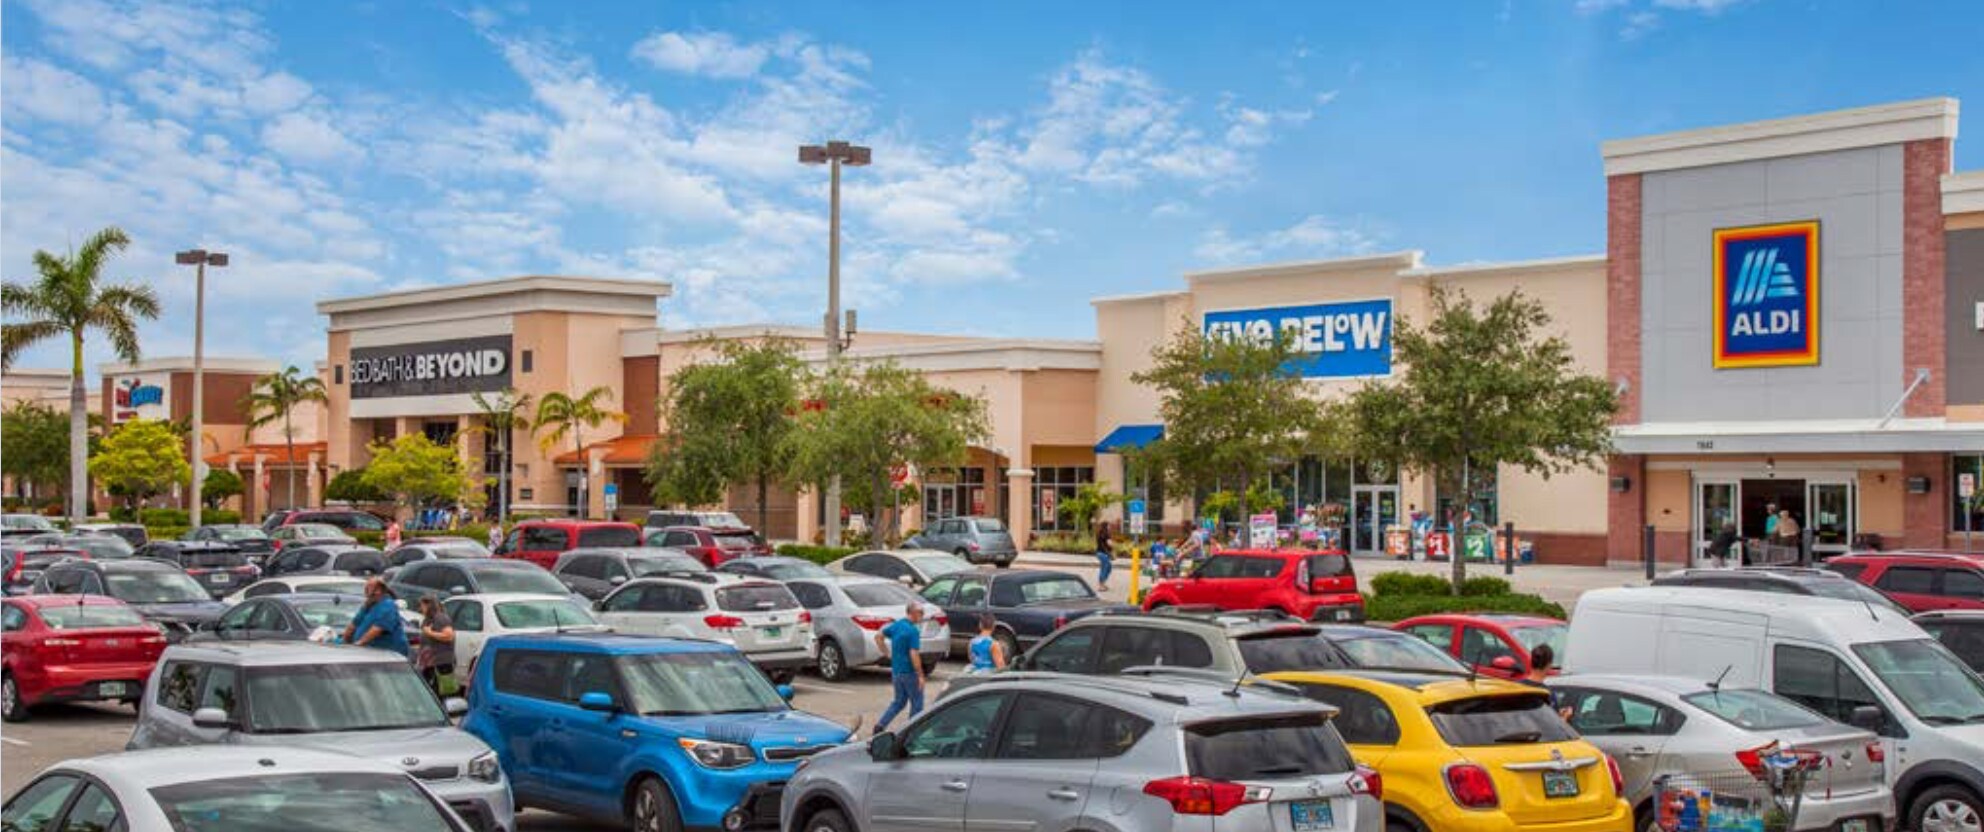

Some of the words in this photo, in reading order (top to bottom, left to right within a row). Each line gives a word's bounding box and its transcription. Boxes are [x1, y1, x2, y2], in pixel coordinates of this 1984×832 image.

[1280, 311, 1387, 353] BELOW
[1731, 308, 1800, 336] ALDI
[350, 360, 371, 383] BED
[372, 356, 403, 383] BATH
[405, 354, 414, 381] &
[416, 349, 506, 380] BEYOND
